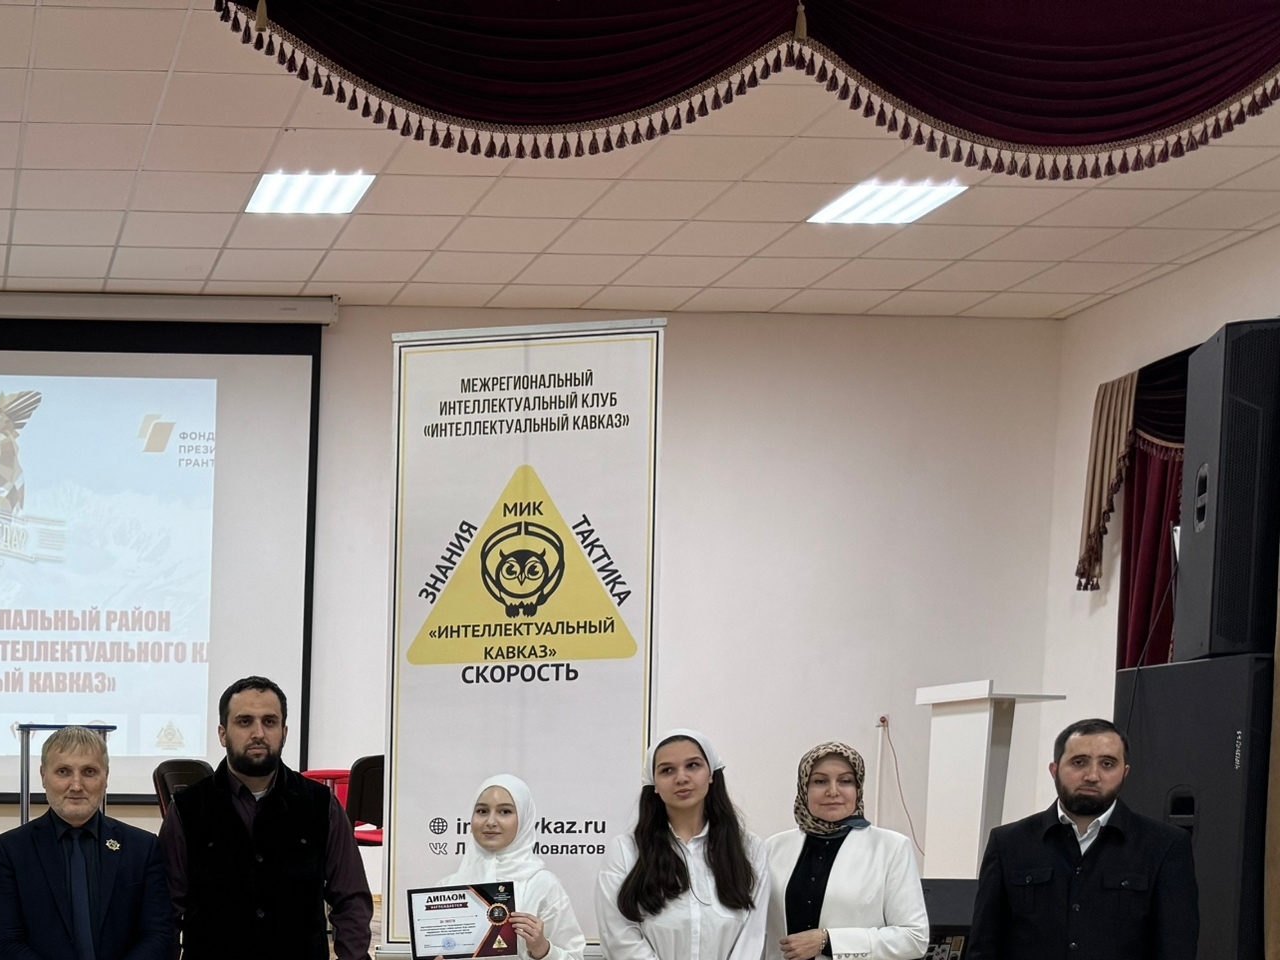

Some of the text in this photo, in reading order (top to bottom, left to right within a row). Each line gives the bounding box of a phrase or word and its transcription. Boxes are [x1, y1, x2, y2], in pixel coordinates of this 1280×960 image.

[460, 369, 594, 394] МЕЖРЕГИОНАЛЬНЫЙ
[439, 391, 618, 416] ИНТЕЛЛЕКТУАЛЬНЫЙ КЛУБ
[423, 413, 630, 438] «ИНТЕЛЛЕКТУАЛЬНЫЙ КАВКАЗ»
[502, 501, 544, 517] МИК
[418, 520, 478, 604] ЗНАНИЯ
[572, 514, 632, 607] ТАКТИКА
[105, 605, 171, 632] РАЙОН
[428, 616, 615, 639] «ИНТЕЛЛЕКТУАЛЬНЫЙ
[483, 645, 557, 660] КАВКАЗ»
[28, 671, 116, 693] КАВКАЗ»
[461, 663, 579, 684] СКОРОСТЬ
[426, 893, 466, 903] ДИПЛОМ
